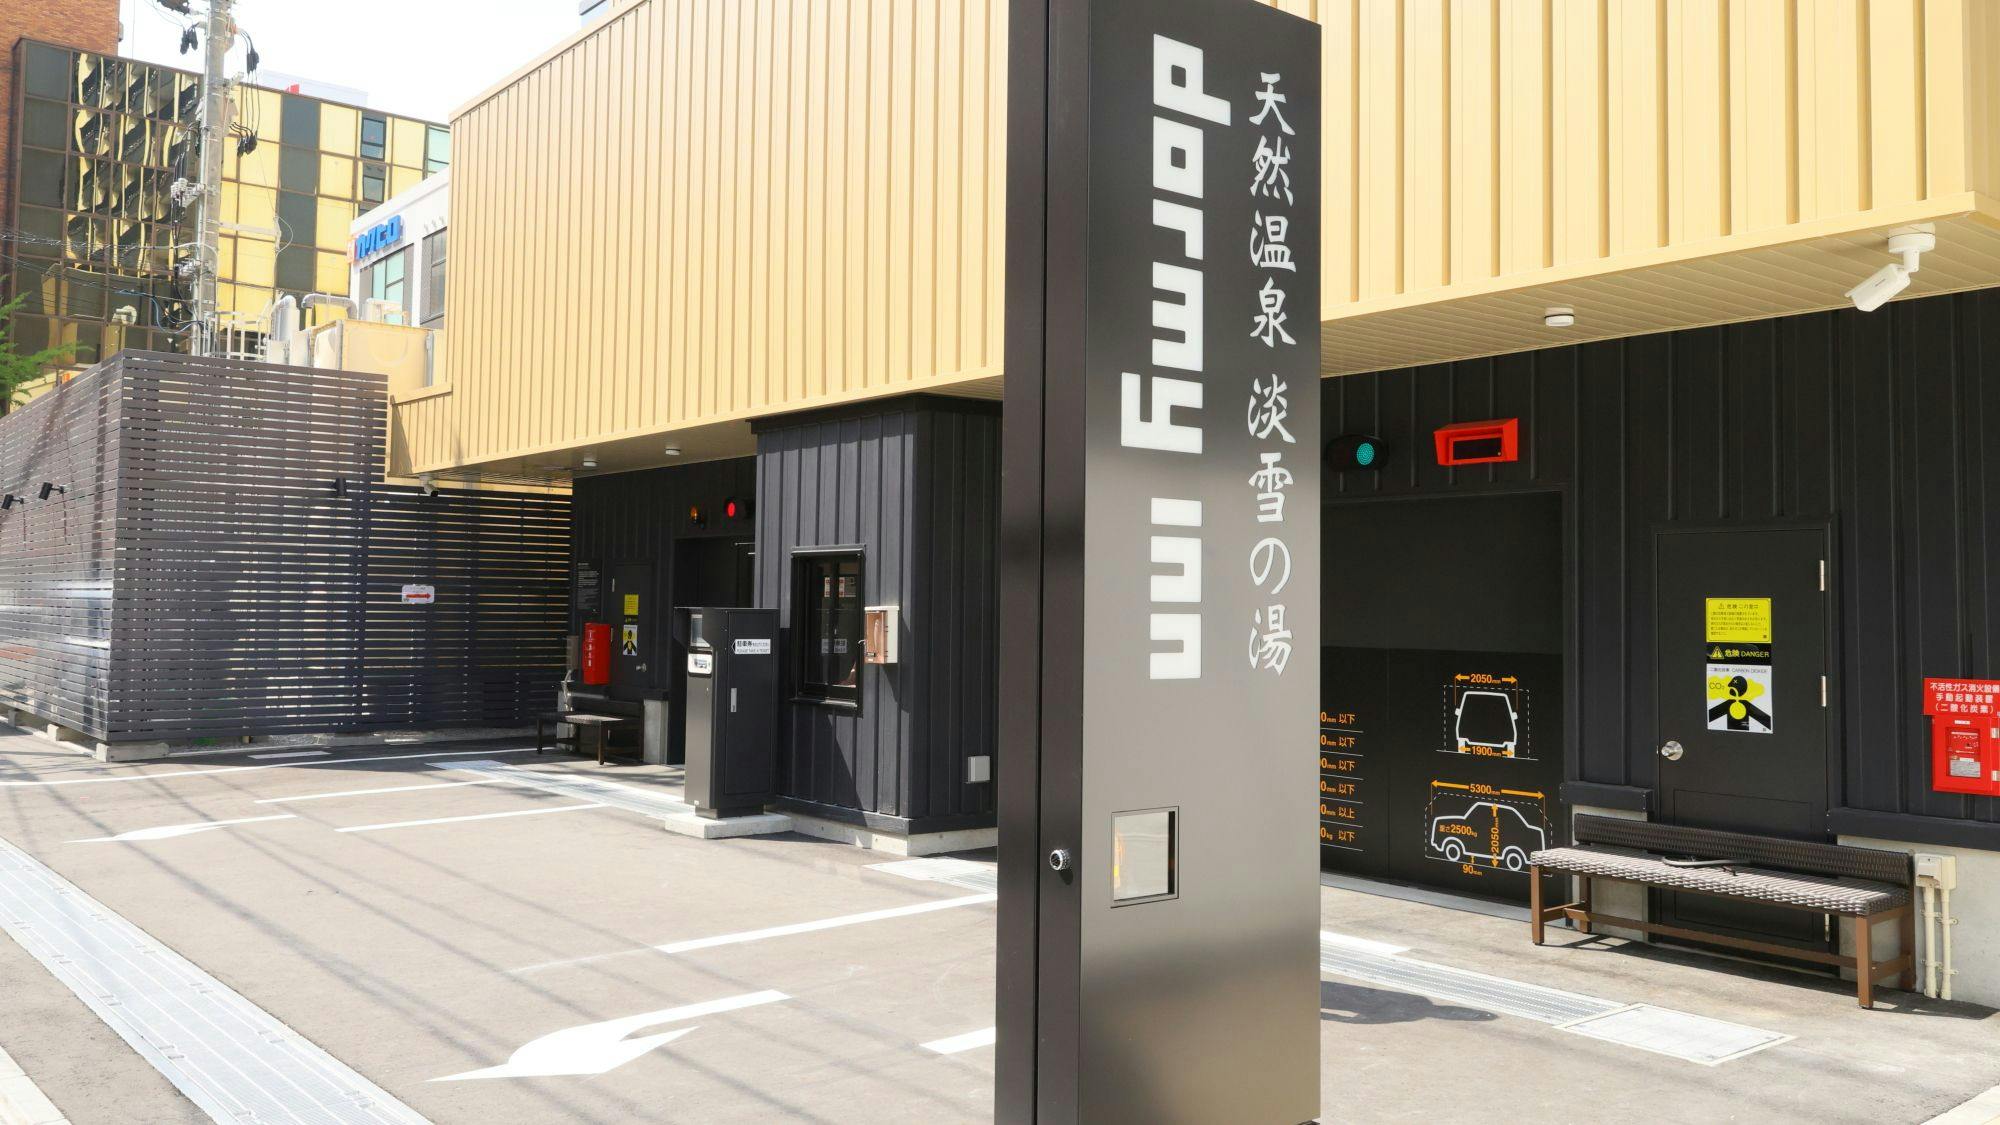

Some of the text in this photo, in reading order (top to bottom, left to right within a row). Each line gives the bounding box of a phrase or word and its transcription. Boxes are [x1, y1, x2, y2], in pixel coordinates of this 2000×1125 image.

[1121, 33, 1231, 680] dormy inn
[1247, 71, 1297, 677] 天然温泉 淡雪の湯
[1725, 648, 1770, 658] 危険 DANGER
[1470, 674, 1501, 684] 2050mm
[1930, 682, 2000, 693] 不活性ガス消火設備
[1936, 693, 1993, 703] 手動起動装置
[1338, 714, 1356, 725] 以下
[1338, 737, 1356, 748] 以下
[1471, 746, 1501, 757] 1900mm
[1338, 760, 1356, 771] 以下
[1338, 783, 1356, 794] 以下
[1470, 784, 1500, 795] 5300mm
[1338, 806, 1356, 819] 以上
[1338, 829, 1356, 842] 以下
[1491, 818, 1500, 853] 2050mm
[1462, 864, 1483, 876] 90mm
